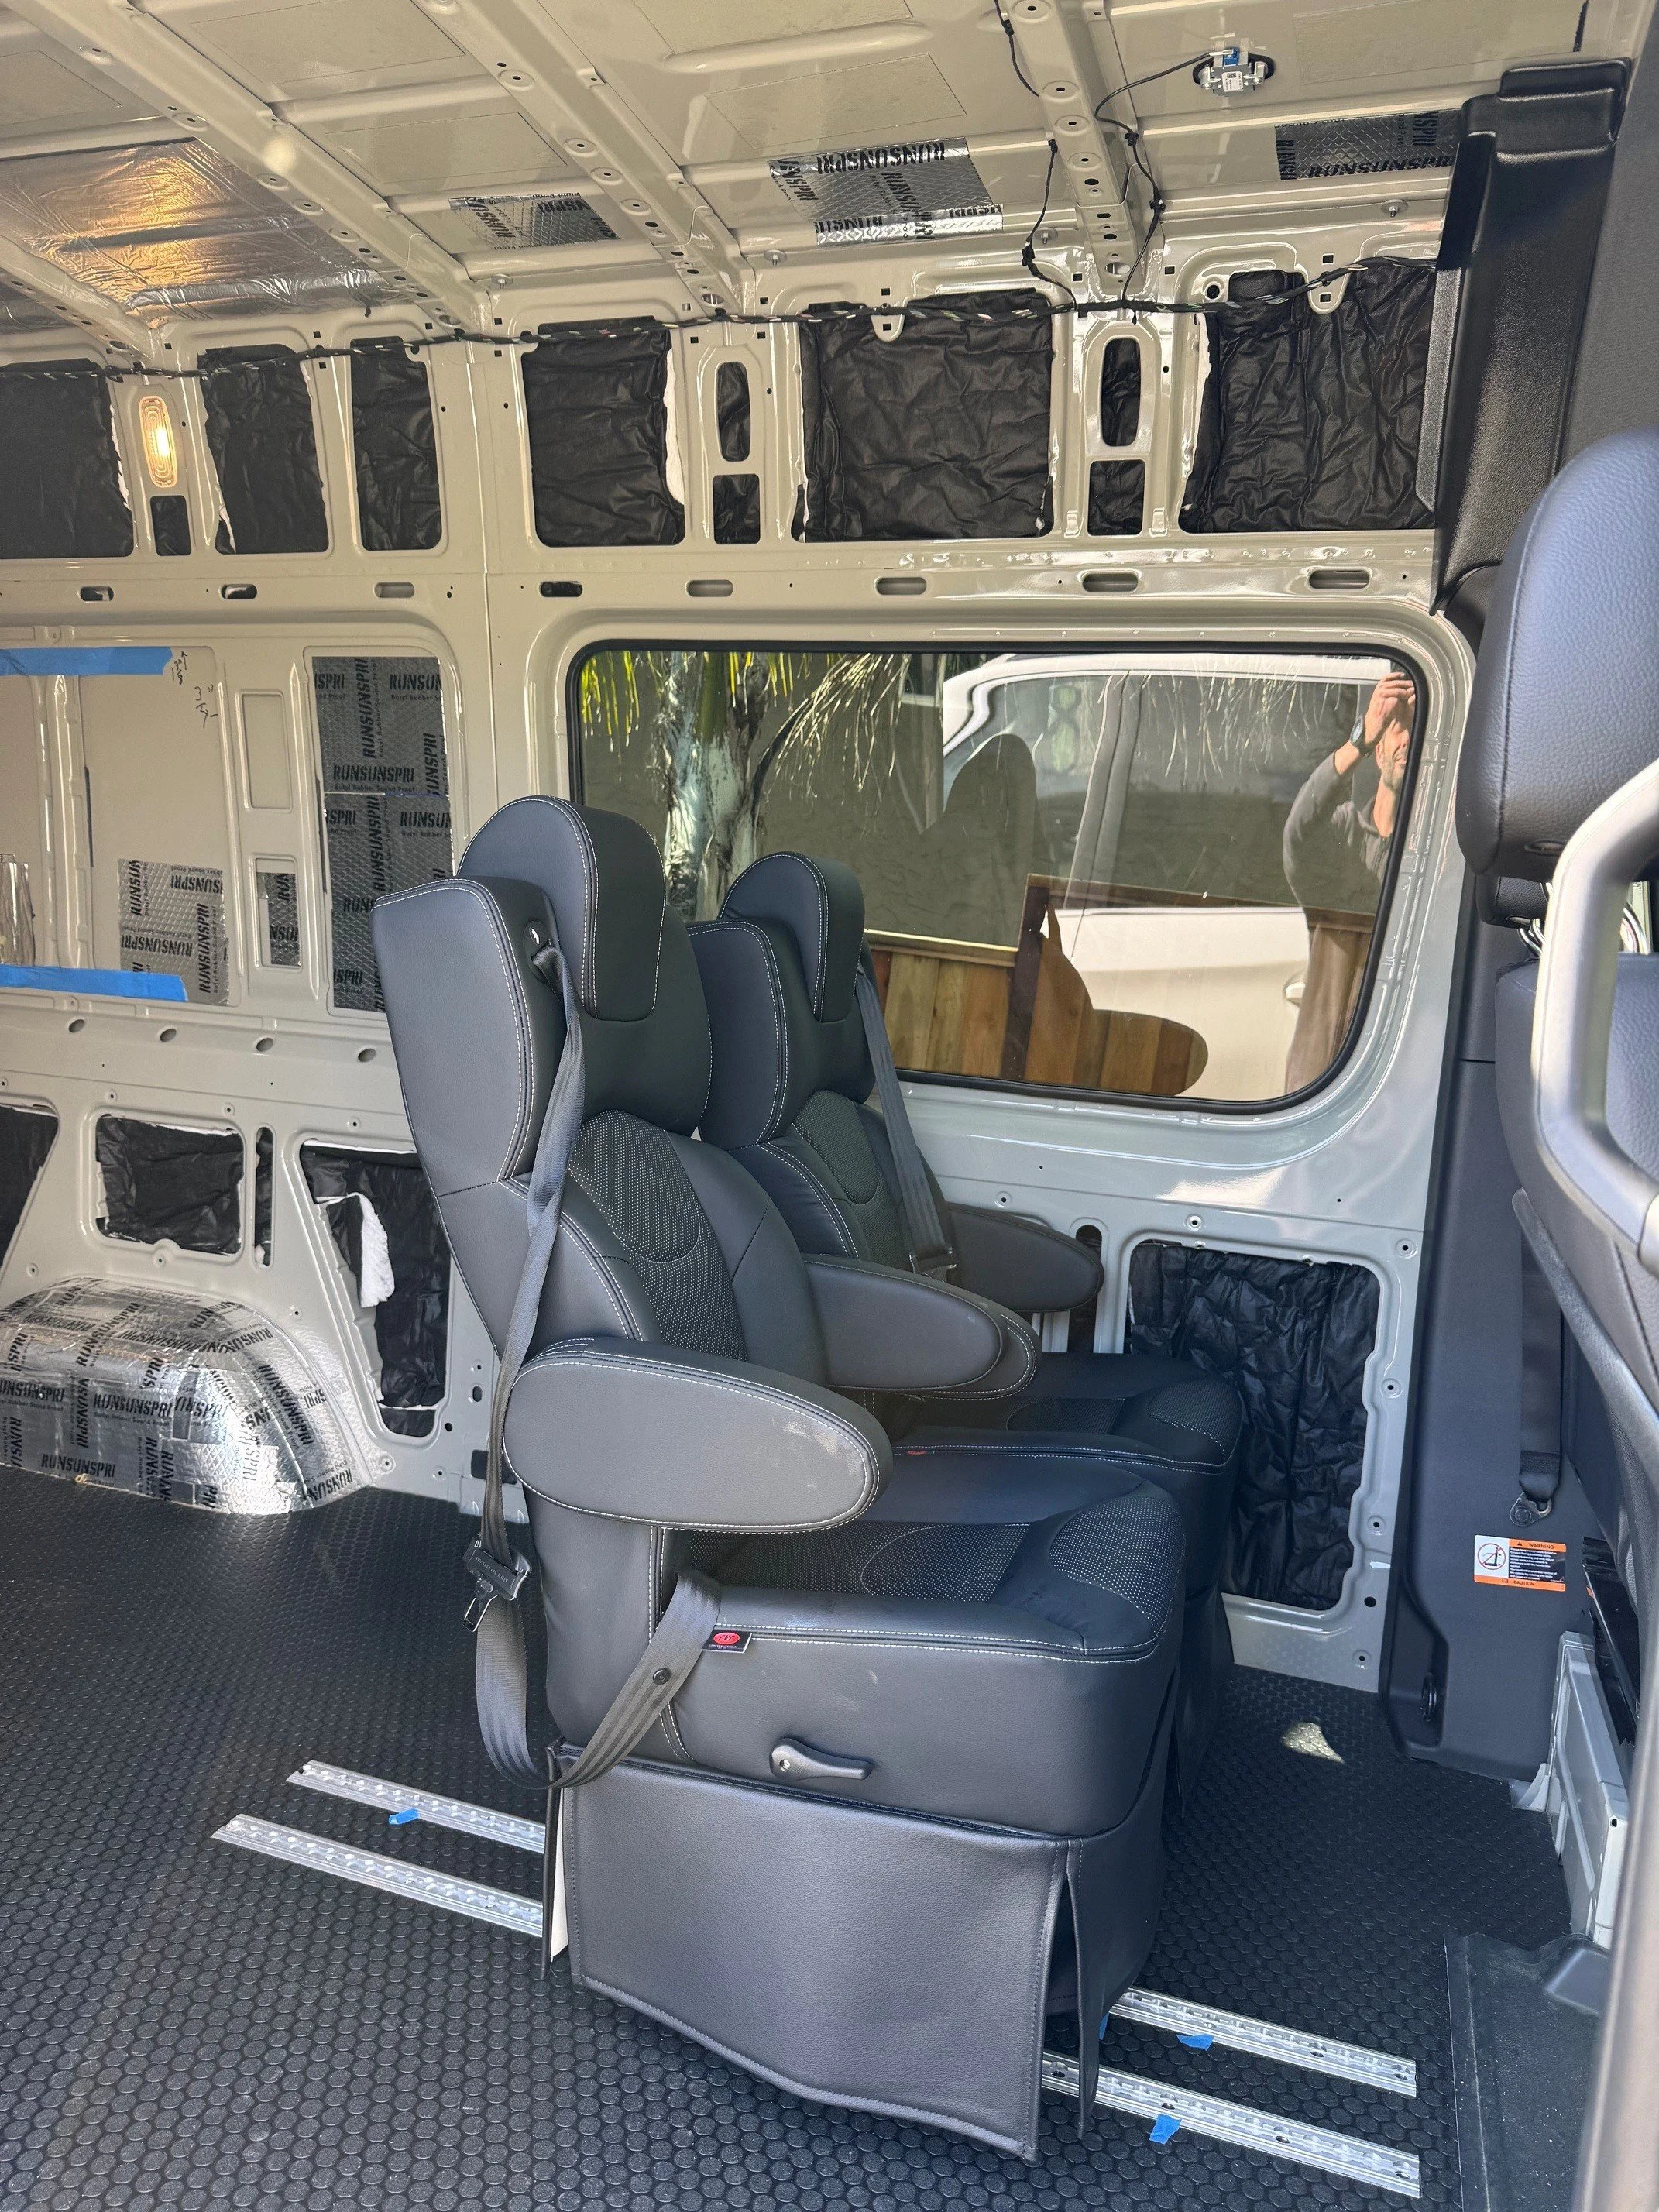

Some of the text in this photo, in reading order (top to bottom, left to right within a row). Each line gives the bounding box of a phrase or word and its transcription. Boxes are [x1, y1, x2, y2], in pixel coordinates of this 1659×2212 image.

[816, 141, 945, 175] RUNSUNSPRI
[355, 658, 376, 758] RUNSUNSPRI
[333, 764, 414, 783] RUNSUNSPRI
[366, 795, 386, 891] RUNSUNSPRI
[121, 934, 194, 957] RUNSUNSPRI
[198, 903, 211, 994] RUNSUNSPRI
[75, 1302, 142, 1367] RUNSUNSPRI
[93, 1393, 173, 1418] RUNSUNSPRI
[258, 1364, 314, 1446] RUNSUNSPRI
[41, 1453, 115, 1478] RUNSUNSPRI
